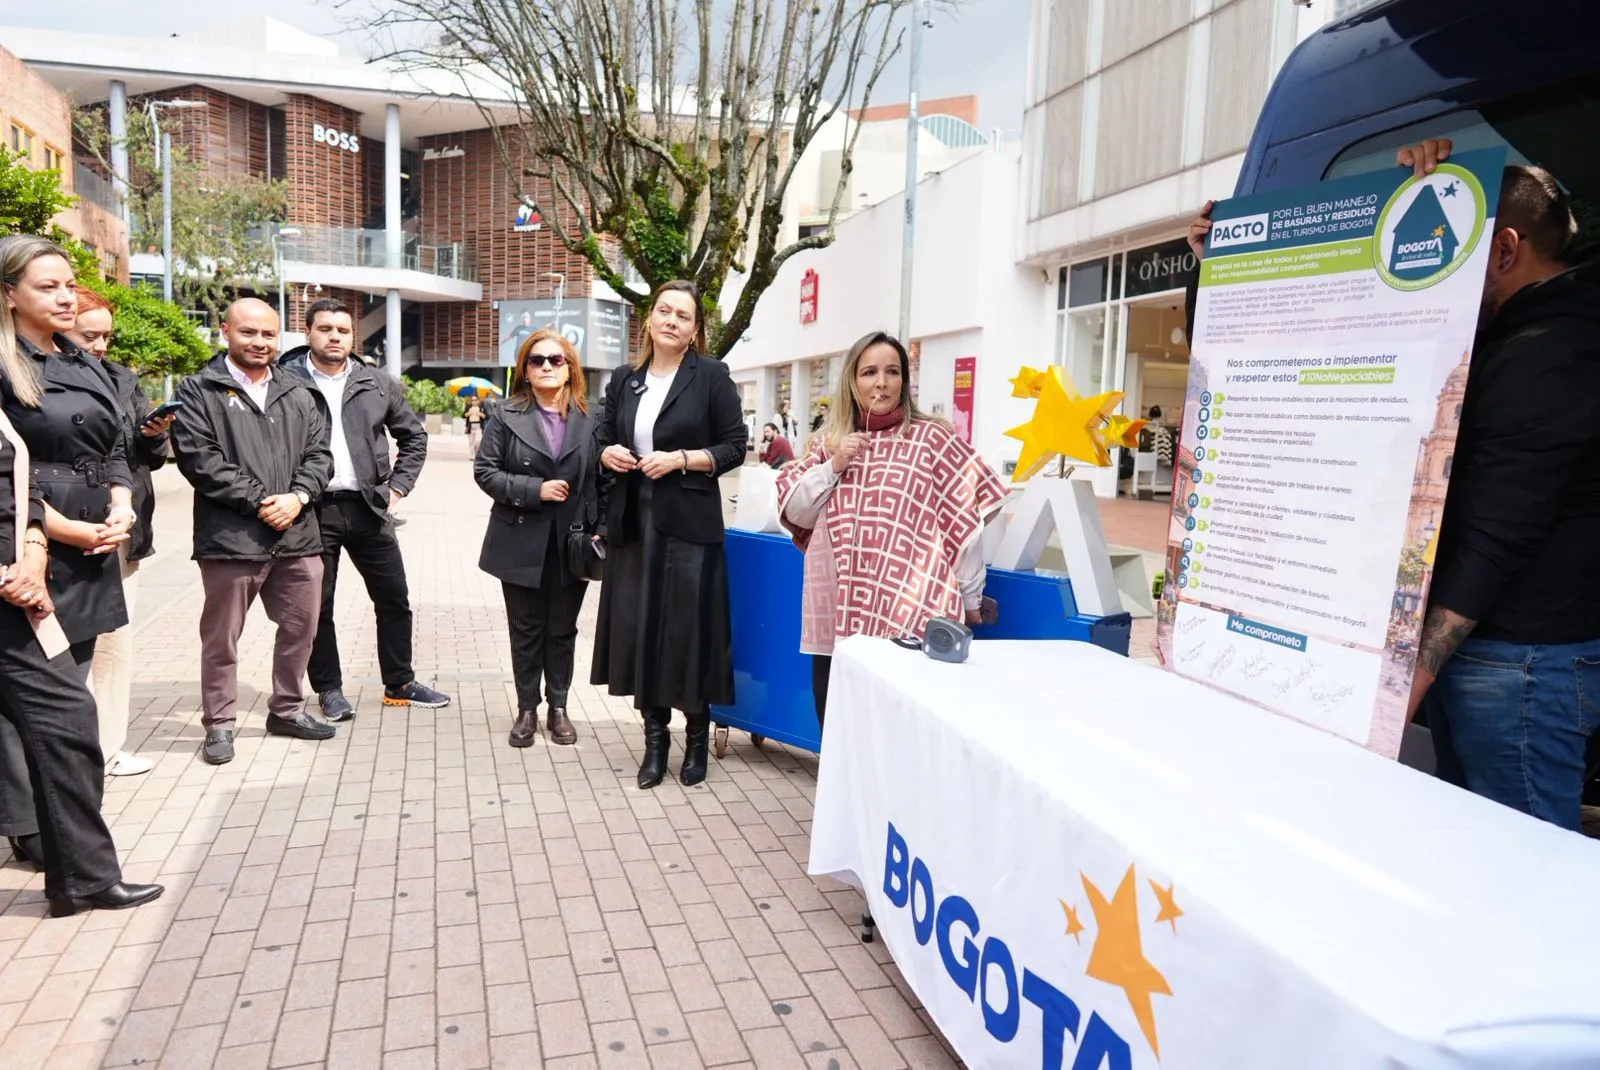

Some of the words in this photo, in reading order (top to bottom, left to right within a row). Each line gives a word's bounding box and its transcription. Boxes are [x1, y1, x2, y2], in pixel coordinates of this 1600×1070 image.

[313, 124, 359, 152] BOSS
[1272, 221, 1282, 230] DE
[1284, 215, 1322, 228] BASURAS
[1324, 213, 1330, 222] Y
[1332, 206, 1376, 220] RESIDUOS
[1273, 209, 1292, 219] POR
[1294, 207, 1304, 216] EL
[1306, 201, 1332, 214] BUEN
[1334, 194, 1377, 209] MANEJO
[1214, 221, 1264, 242] PACTO
[1271, 232, 1280, 240] EN
[1293, 225, 1326, 236] TURISMO
[1328, 224, 1338, 232] DE
[1140, 252, 1196, 280] OYSHO
[1227, 360, 1243, 368] Nos
[1245, 358, 1322, 368] comprometemos
[1333, 354, 1397, 366] implementar
[1226, 376, 1231, 384] y
[1232, 374, 1270, 384] respetar
[1273, 373, 1298, 382] estos
[1231, 620, 1244, 631] Me
[1245, 625, 1302, 647] comprometo
